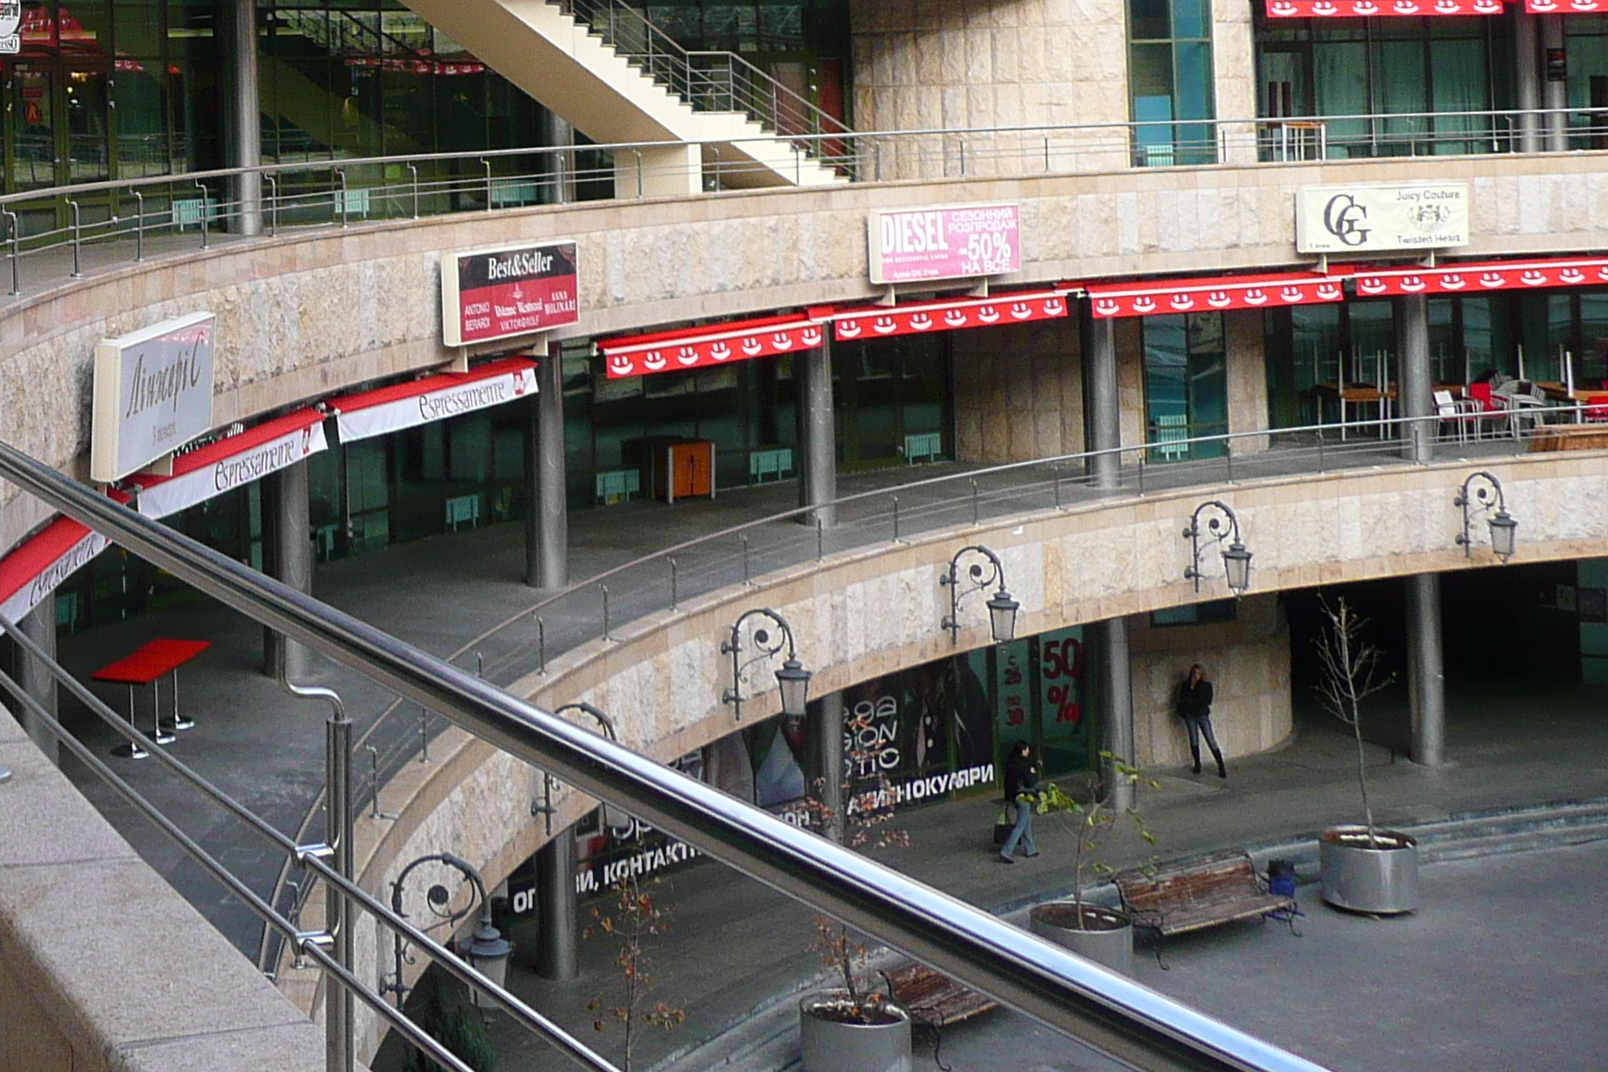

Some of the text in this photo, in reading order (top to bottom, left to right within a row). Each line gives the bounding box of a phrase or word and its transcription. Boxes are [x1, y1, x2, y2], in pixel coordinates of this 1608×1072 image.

[1396, 190, 1461, 202] Juicy Couture
[948, 218, 1018, 234] РОЗПРОДАЖ
[951, 207, 1014, 223] СЕЗОННИЙ
[880, 211, 949, 255] DIESEL
[959, 231, 1012, 262] -50%
[488, 252, 554, 280] Best&Seller
[962, 259, 1011, 275] НА ВСЕ
[418, 382, 506, 421] espressamente
[214, 440, 295, 492] espressamente
[1042, 637, 1082, 680] 50
